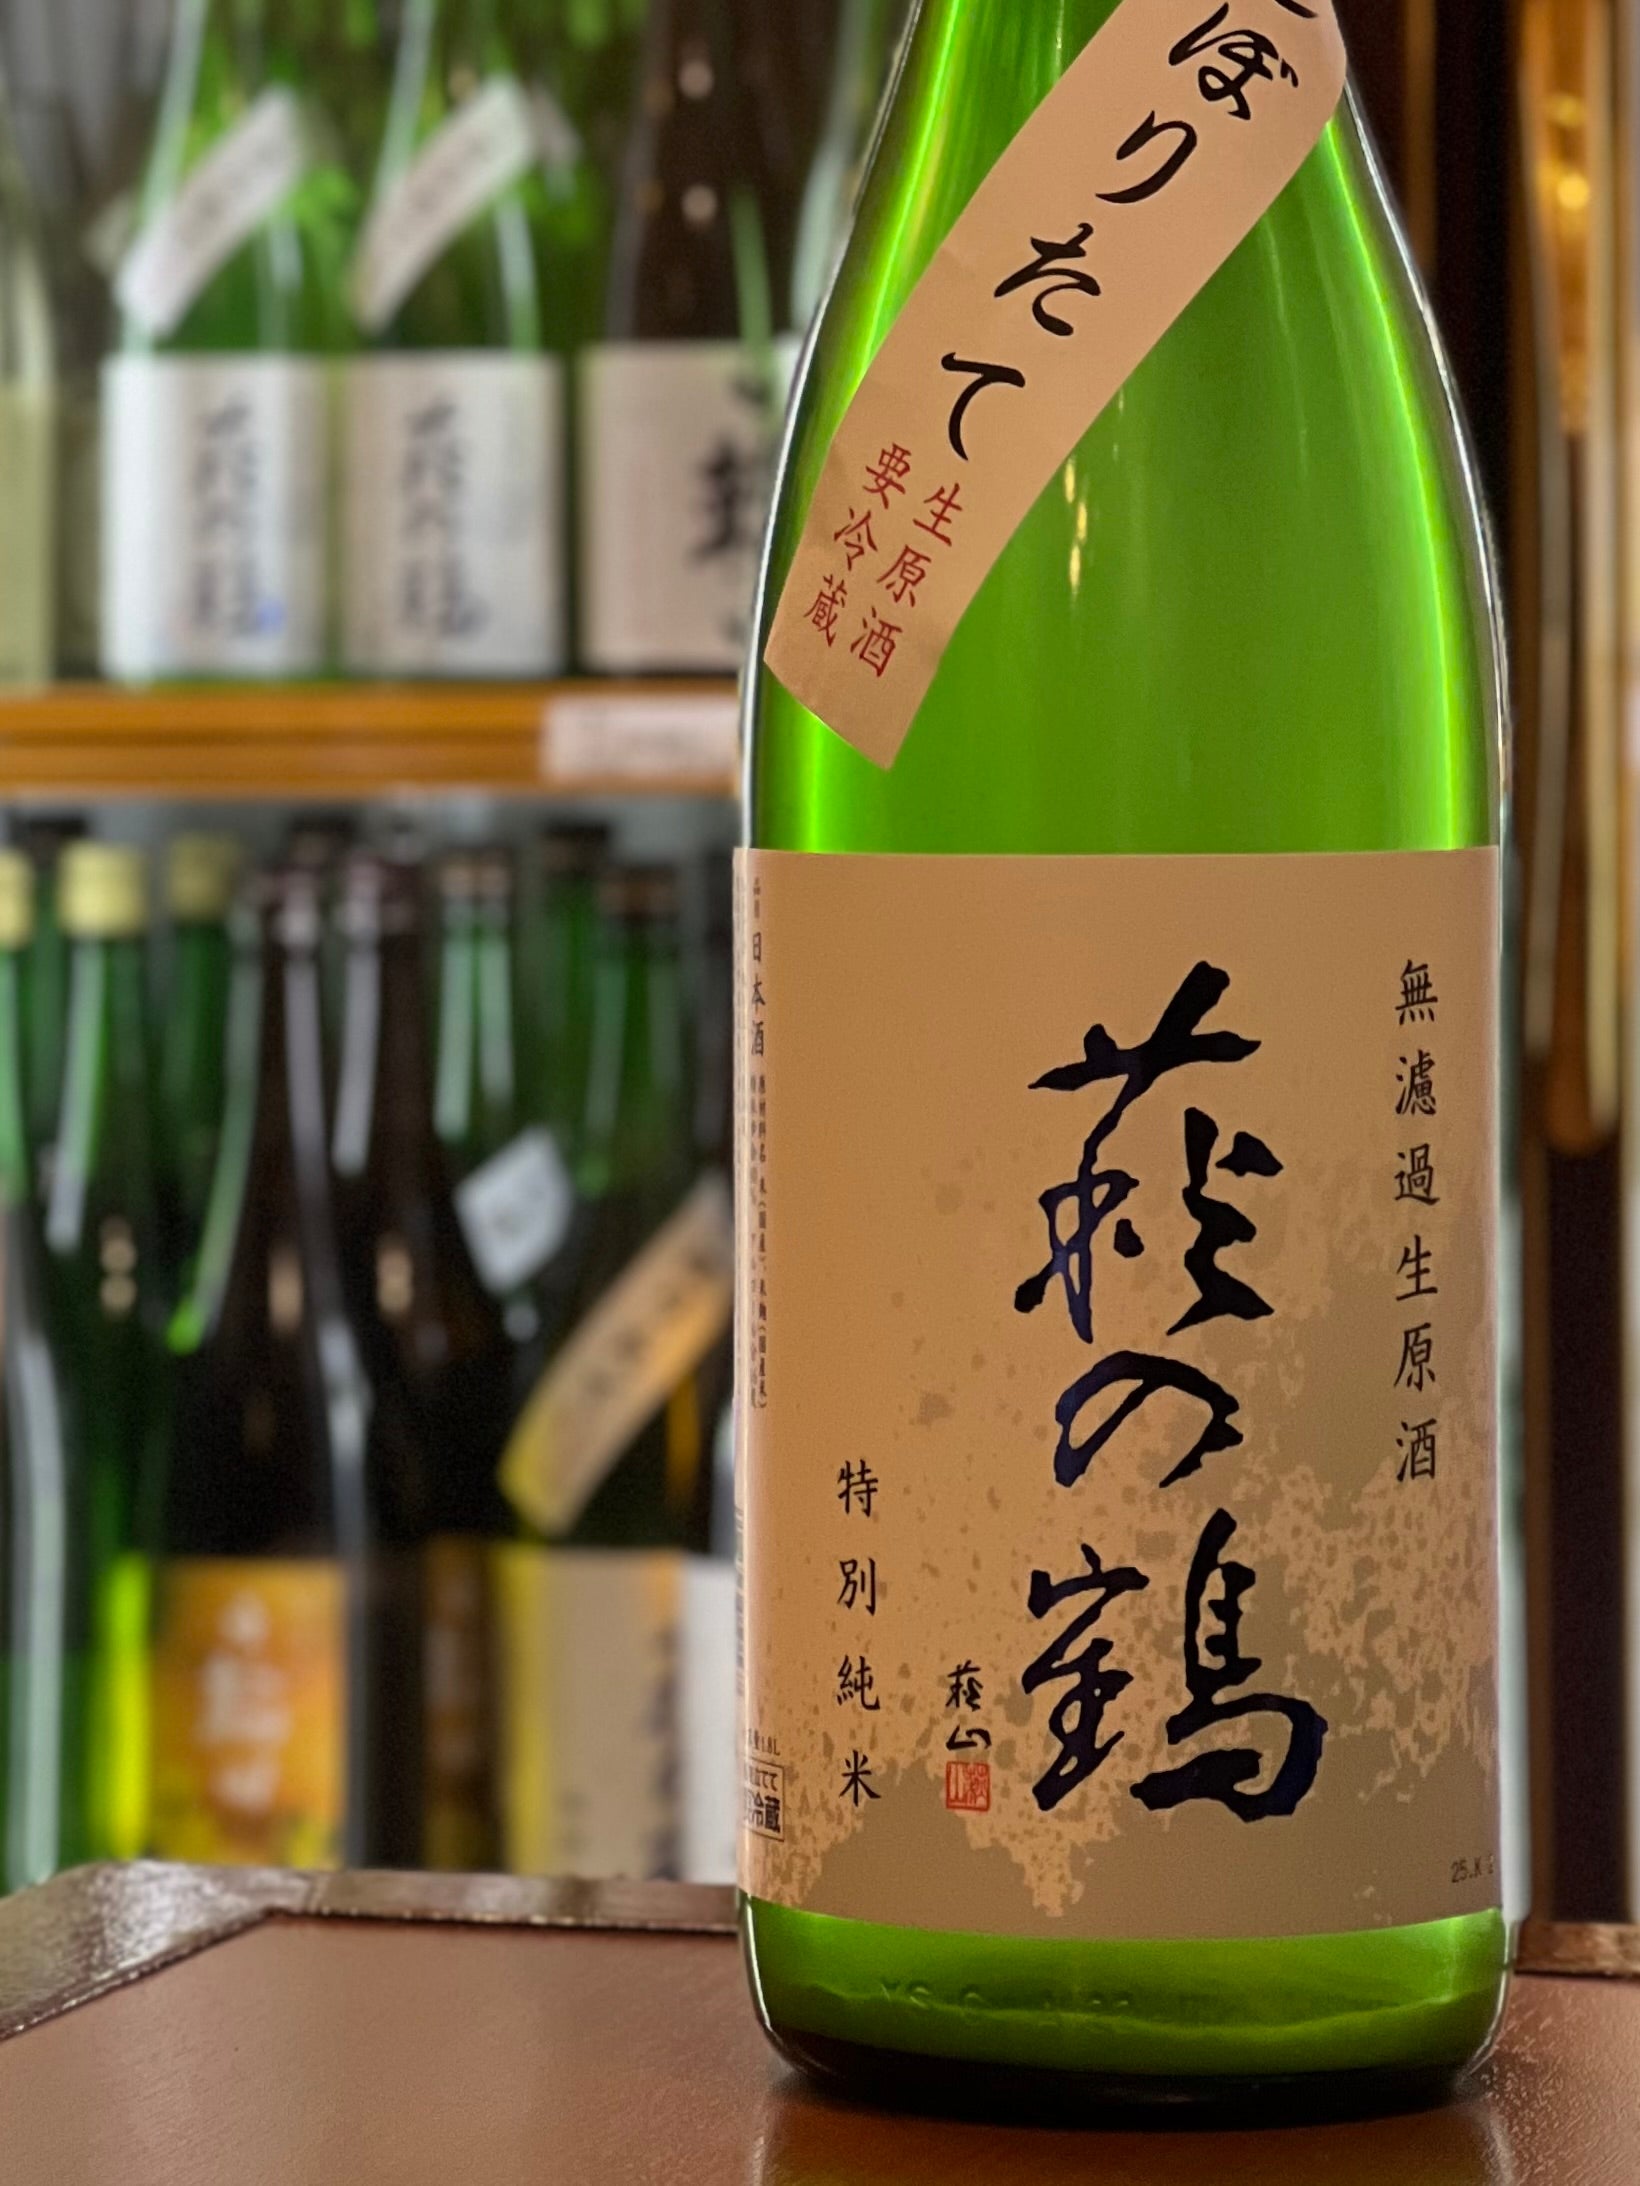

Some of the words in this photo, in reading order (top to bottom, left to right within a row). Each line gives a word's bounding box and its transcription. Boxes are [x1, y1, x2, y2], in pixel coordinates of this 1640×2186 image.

[941, 0, 1318, 460] ぼりたて
[803, 443, 912, 648] 要冷蔵
[850, 482, 963, 678] 生原酒
[1014, 960, 1329, 1822] 萩の鶴
[1394, 959, 1441, 1482] 無濾過生原酒
[836, 1460, 881, 1807] 特別純米
